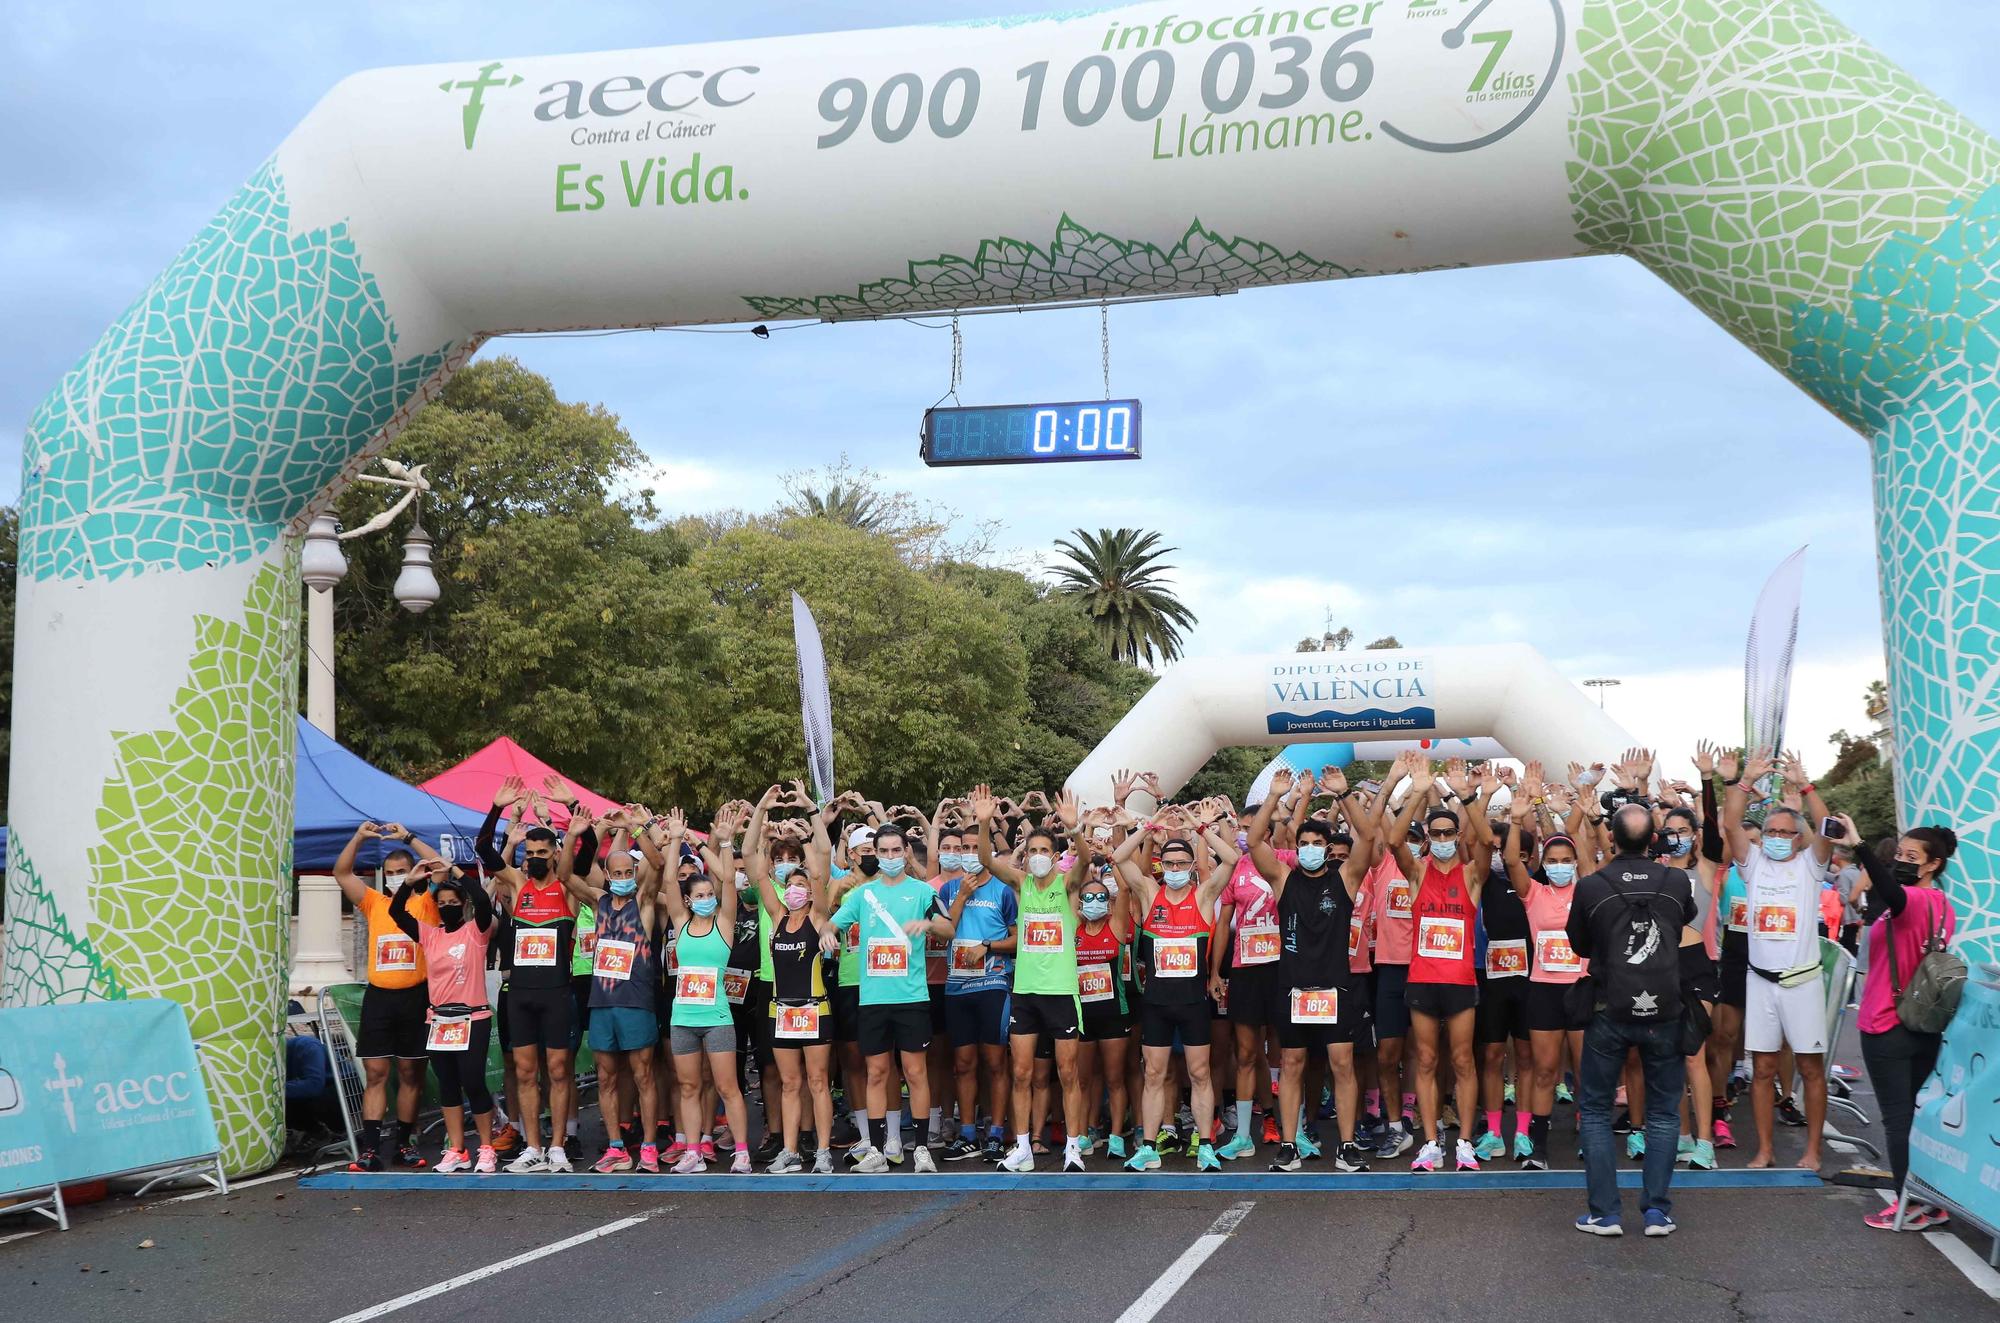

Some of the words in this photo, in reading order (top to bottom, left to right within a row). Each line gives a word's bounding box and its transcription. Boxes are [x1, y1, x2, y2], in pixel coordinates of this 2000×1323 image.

[1406, 7, 1448, 20] horas
[1102, 1, 1384, 51] infocáncer
[1467, 30, 1513, 92] 7
[1492, 70, 1535, 92] días
[534, 65, 760, 122] aecc
[817, 67, 981, 149] 900
[1016, 49, 1176, 131] 100
[1200, 28, 1374, 114] 036
[1466, 94, 1473, 103] a
[1475, 92, 1486, 103] la
[1488, 89, 1535, 100] semana
[570, 127, 629, 147] Contra
[636, 124, 650, 142] el
[656, 120, 716, 140] Cáncer
[1152, 110, 1373, 160] Llámame.
[556, 163, 605, 212] Es
[620, 152, 749, 208] Vida.
[1273, 662, 1388, 676] DIPUTACIÓ
[1398, 661, 1424, 671] DE
[1272, 677, 1427, 702] VALÈNCIA
[1287, 720, 1331, 731] Joventut,
[1333, 719, 1370, 729] Esports
[1380, 717, 1416, 728] Igualtat
[1765, 914, 1788, 928] 646
[1032, 929, 1056, 942] 1757
[1432, 933, 1455, 947] 1164
[388, 947, 407, 960] 1171
[527, 943, 548, 955] 1218
[1255, 940, 1274, 953] 694
[1550, 946, 1573, 960] 333
[604, 954, 624, 967] 725
[877, 953, 901, 966] 1848
[1165, 953, 1191, 966] 1498
[1498, 955, 1518, 968] 428
[687, 981, 708, 994] 948
[724, 981, 742, 993] 723
[1082, 977, 1106, 992] 1390
[1306, 999, 1329, 1012] 1612
[791, 1015, 809, 1028] 106
[94, 1071, 191, 1114] aecc
